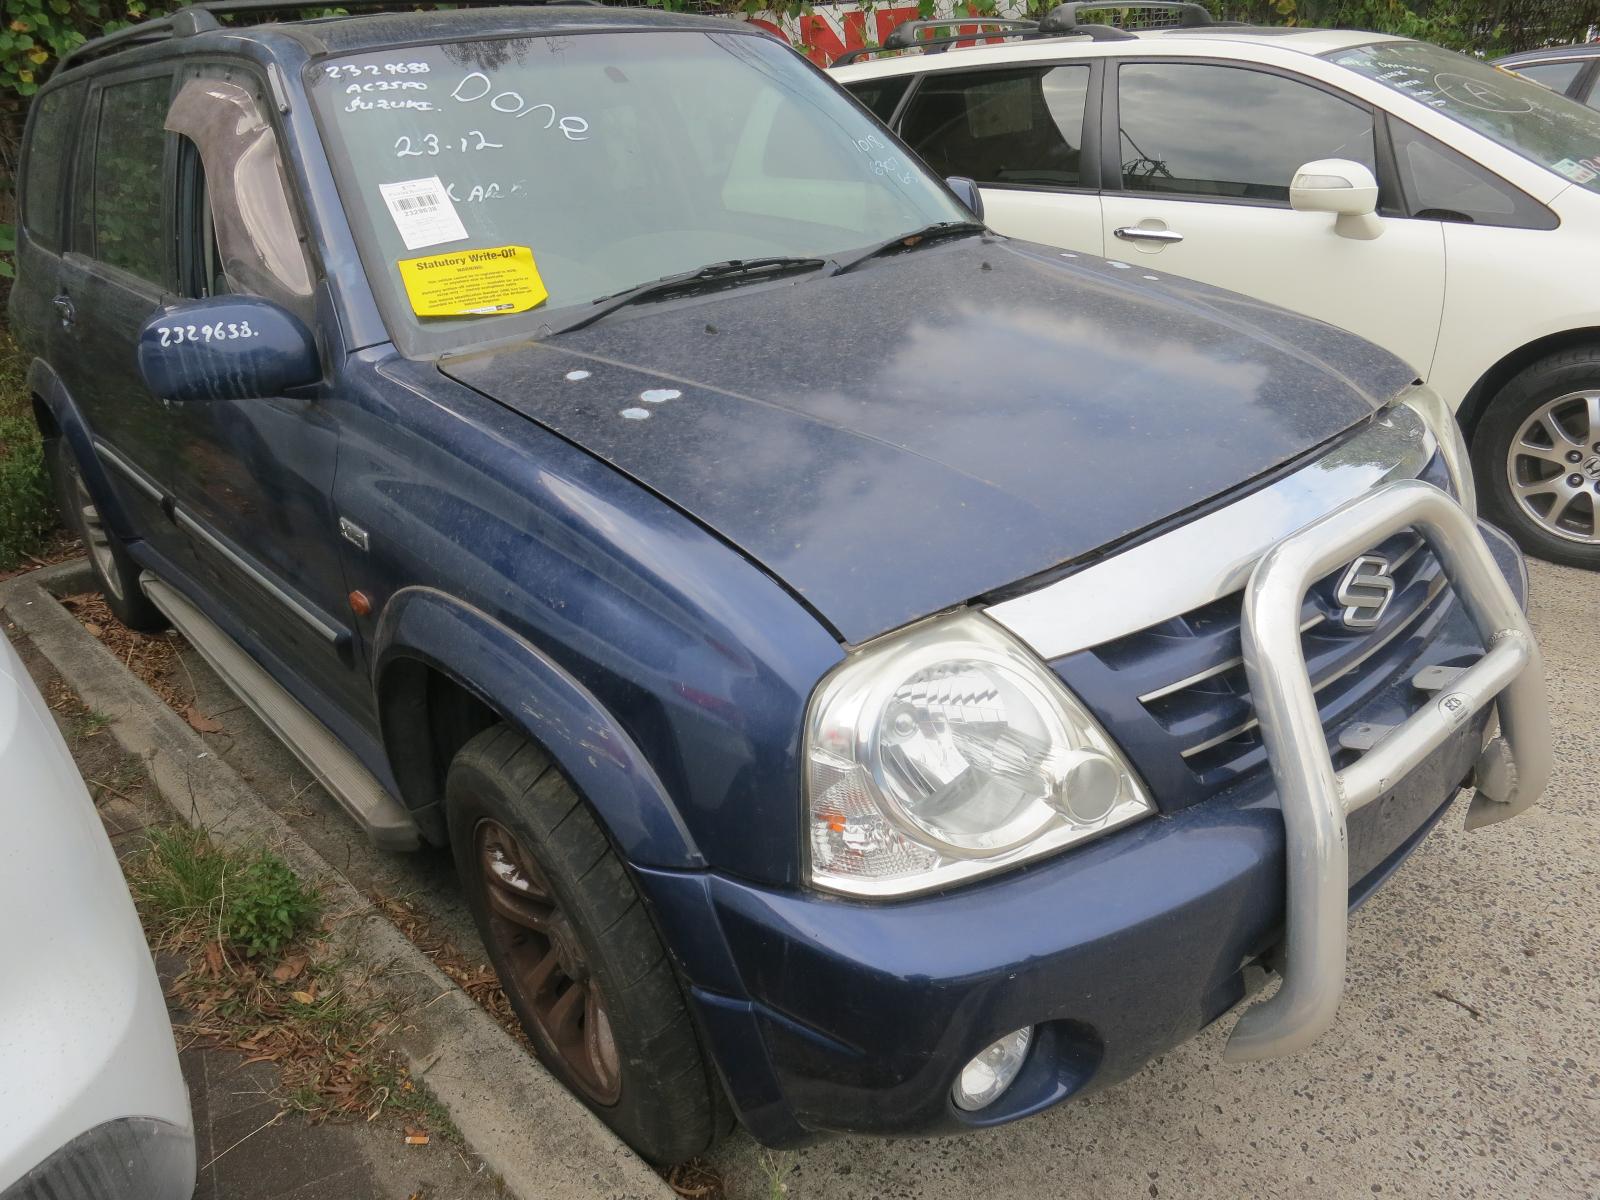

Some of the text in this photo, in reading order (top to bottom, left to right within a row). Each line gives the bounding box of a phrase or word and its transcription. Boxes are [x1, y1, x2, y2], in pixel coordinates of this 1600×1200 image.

[450, 72, 590, 140] Done
[416, 248, 516, 271] Statutory Write-Off
